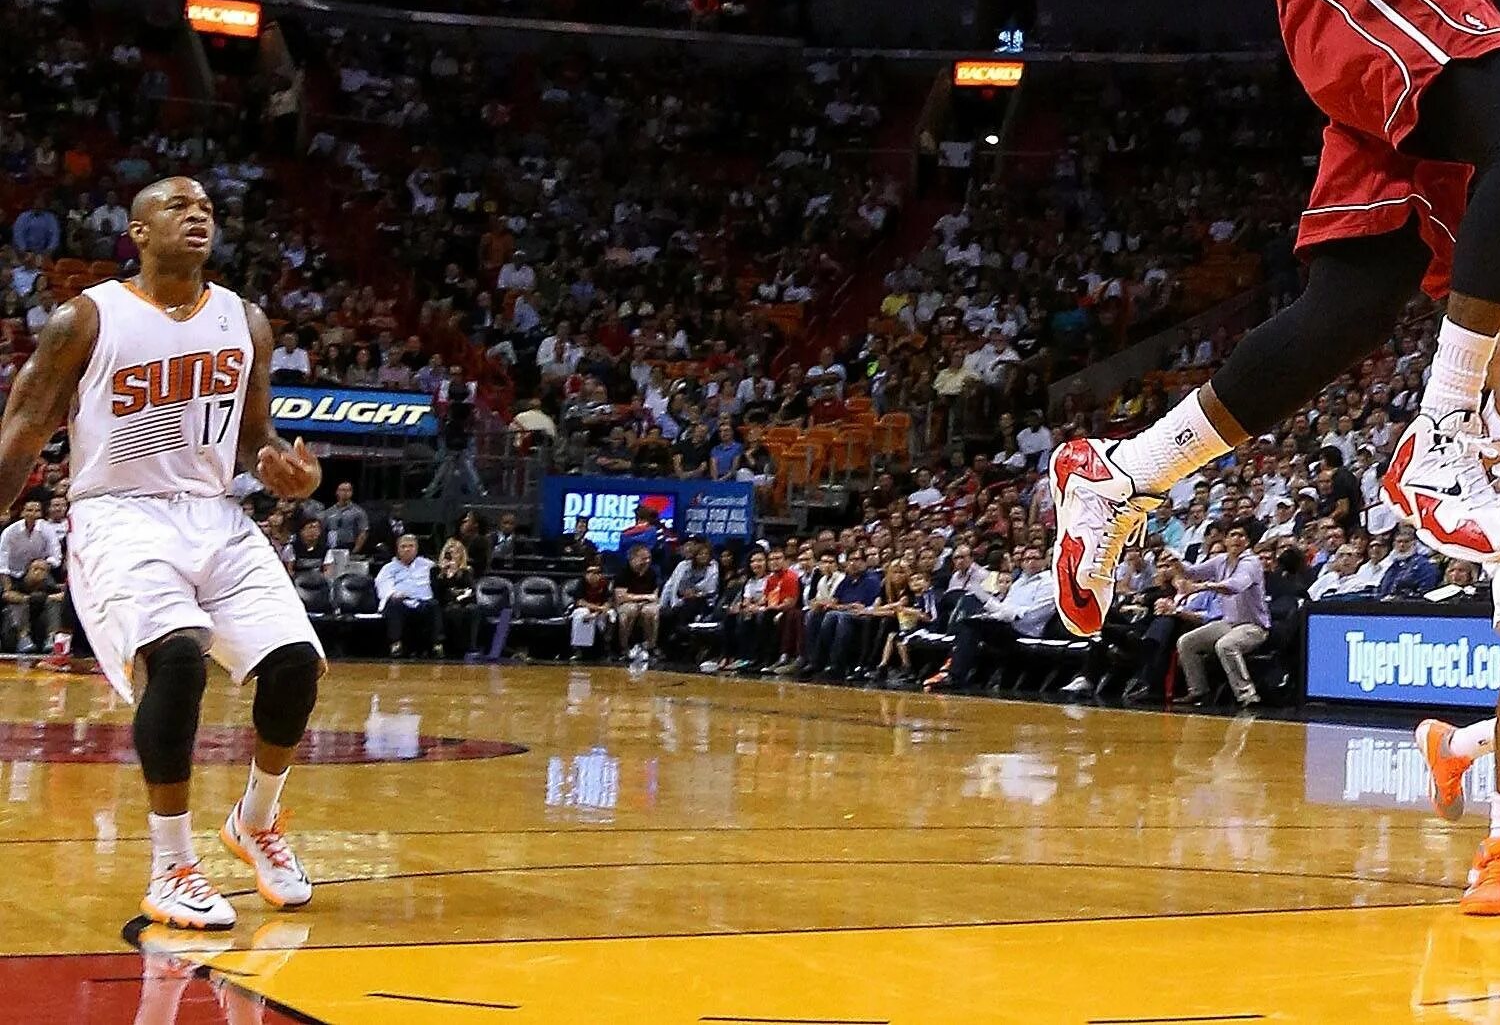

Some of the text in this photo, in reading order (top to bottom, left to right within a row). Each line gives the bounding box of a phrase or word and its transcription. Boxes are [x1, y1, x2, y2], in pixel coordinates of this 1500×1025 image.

[201, 399, 235, 445] 17
[310, 397, 431, 424] LIGHT
[564, 493, 640, 518] DJ IRIE
